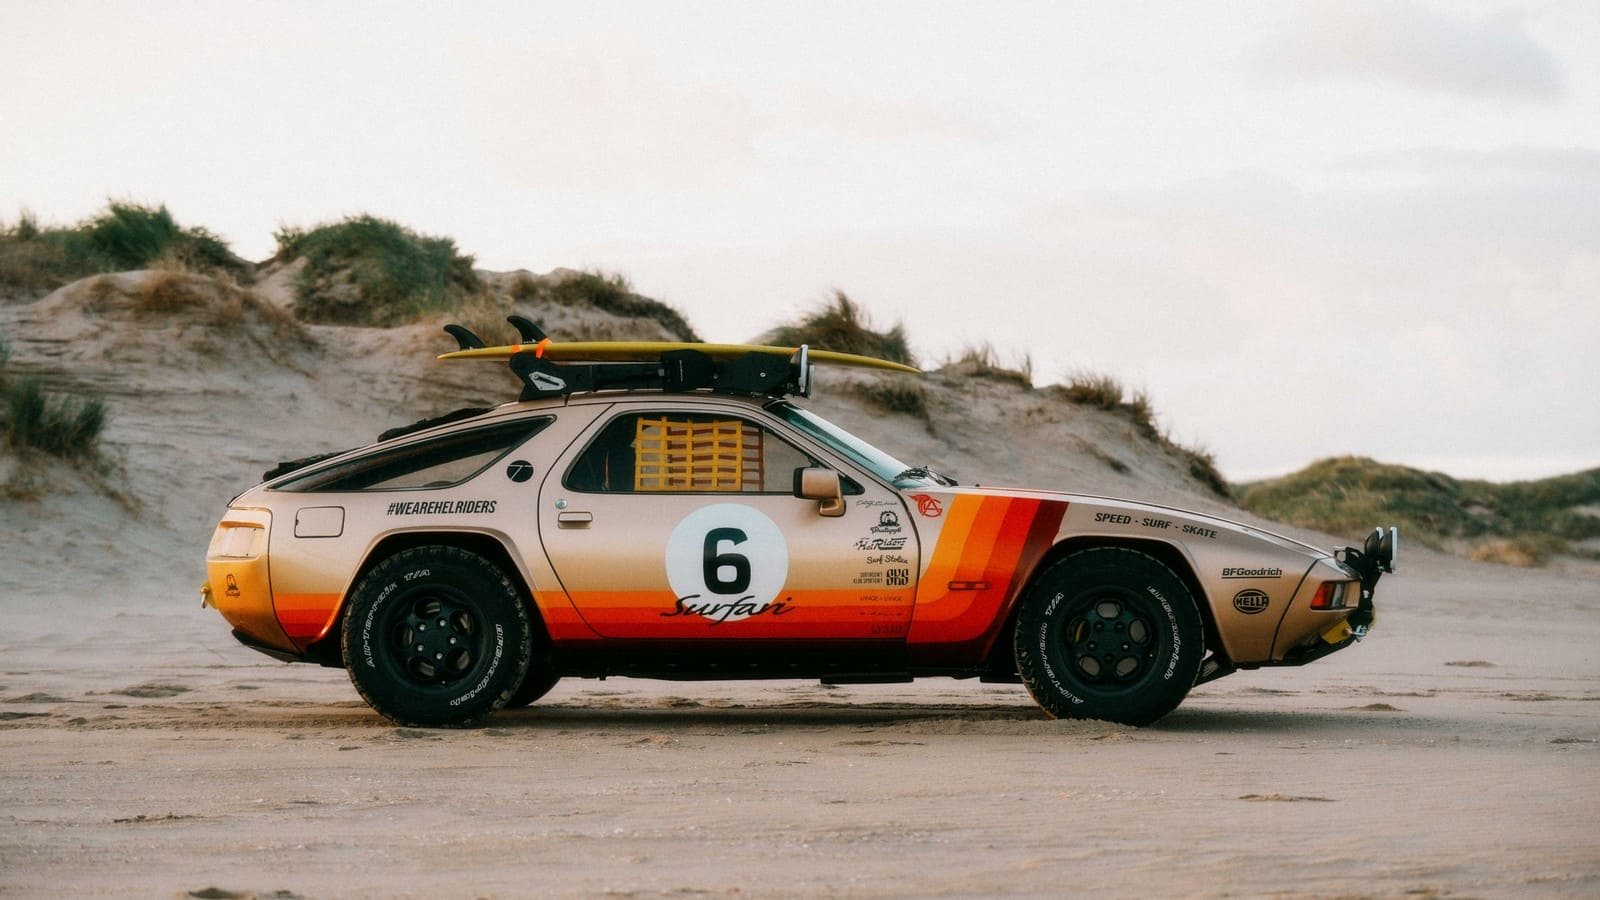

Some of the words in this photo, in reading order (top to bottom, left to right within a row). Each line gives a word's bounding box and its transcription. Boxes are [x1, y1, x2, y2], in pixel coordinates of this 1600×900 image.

[387, 500, 497, 516] #WEAREHELRIDERS
[1095, 512, 1131, 525] SPEED
[1142, 518, 1172, 530] SURF
[1182, 524, 1218, 540] SKATE
[703, 527, 751, 595] 6
[866, 554, 883, 565] Surf
[404, 569, 431, 581] T/A
[1222, 567, 1283, 577] BFGoodrich
[660, 594, 796, 627] Surfari
